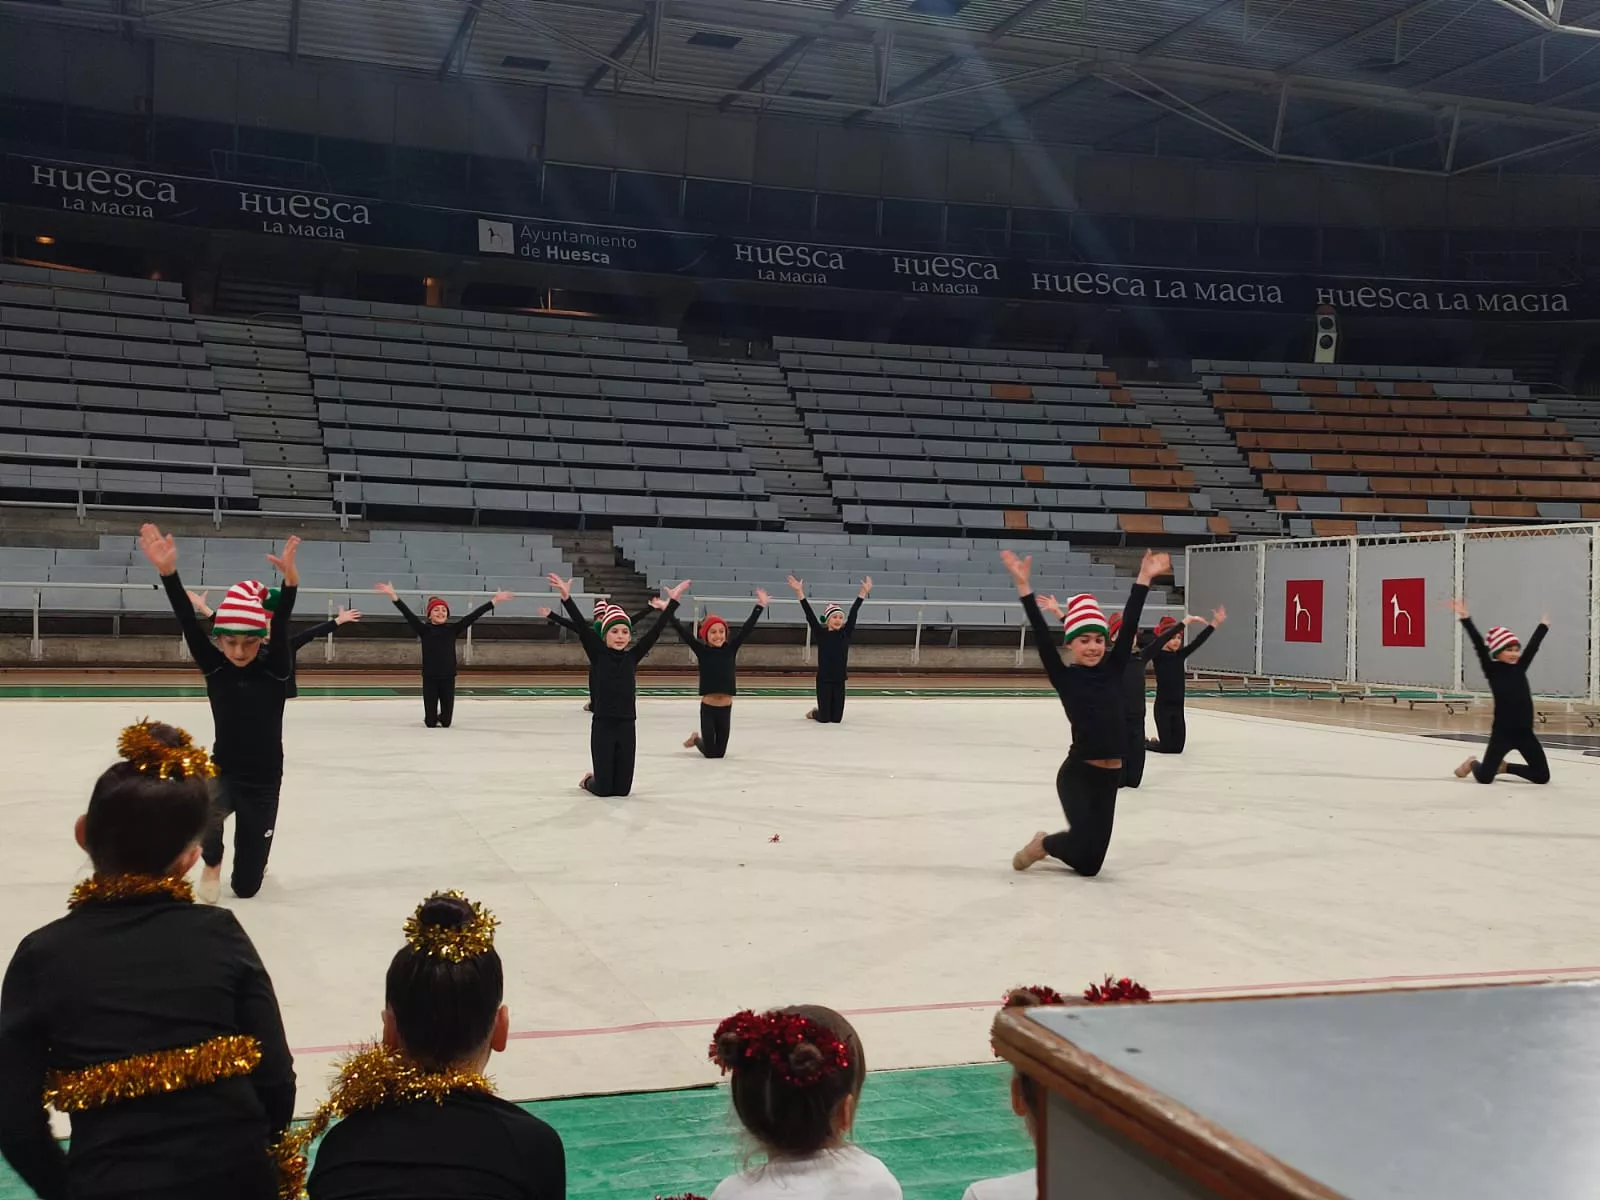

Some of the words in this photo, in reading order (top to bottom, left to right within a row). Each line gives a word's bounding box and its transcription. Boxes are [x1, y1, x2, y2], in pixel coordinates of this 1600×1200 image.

[32, 163, 178, 204] Huesca
[239, 190, 372, 226] Huesca
[519, 223, 638, 250] Ayuntamiento
[519, 242, 541, 258] de
[546, 244, 611, 265] Huesca
[735, 242, 846, 271] Huesca
[893, 255, 1000, 281] Huesca
[1032, 270, 1147, 298] Huesca
[1316, 286, 1431, 311] Huesca
